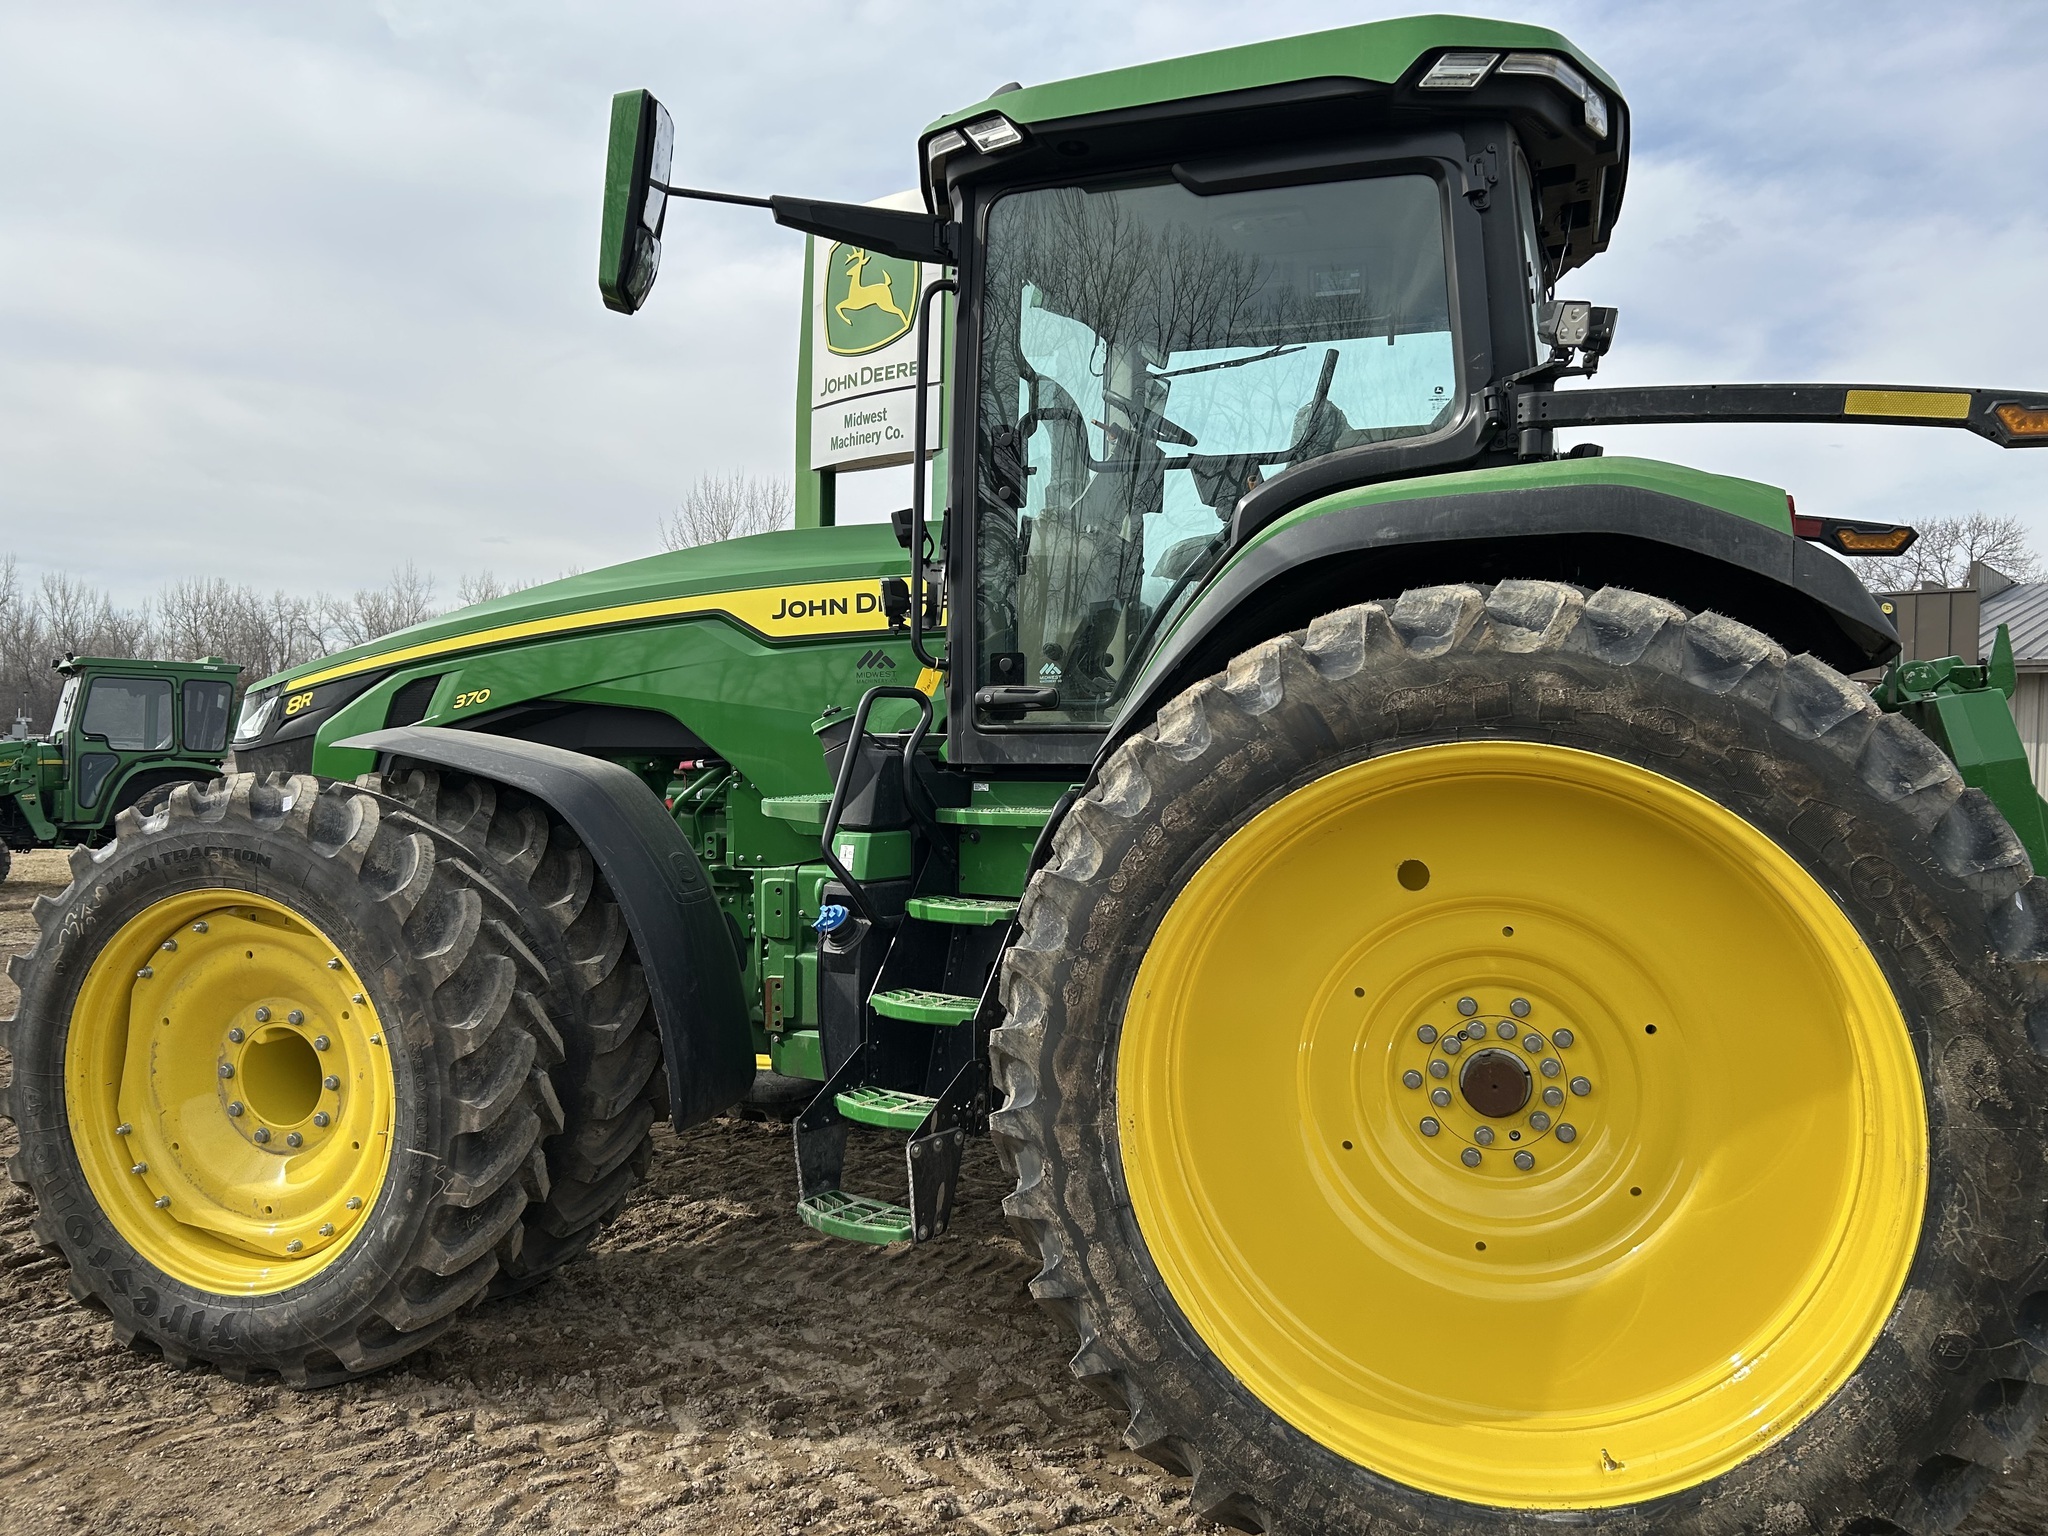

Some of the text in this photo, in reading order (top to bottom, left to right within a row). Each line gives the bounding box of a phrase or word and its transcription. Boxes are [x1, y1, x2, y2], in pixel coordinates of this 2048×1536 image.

[820, 360, 918, 397] JOHN DEERE
[844, 407, 888, 429] Midwest
[830, 426, 905, 451] Machinery Co.
[771, 597, 849, 620] JOHN
[856, 670, 897, 679] MIDWEST
[285, 691, 314, 716] 8R
[452, 688, 491, 710] 370
[104, 845, 273, 896] MAXI TRACTION
